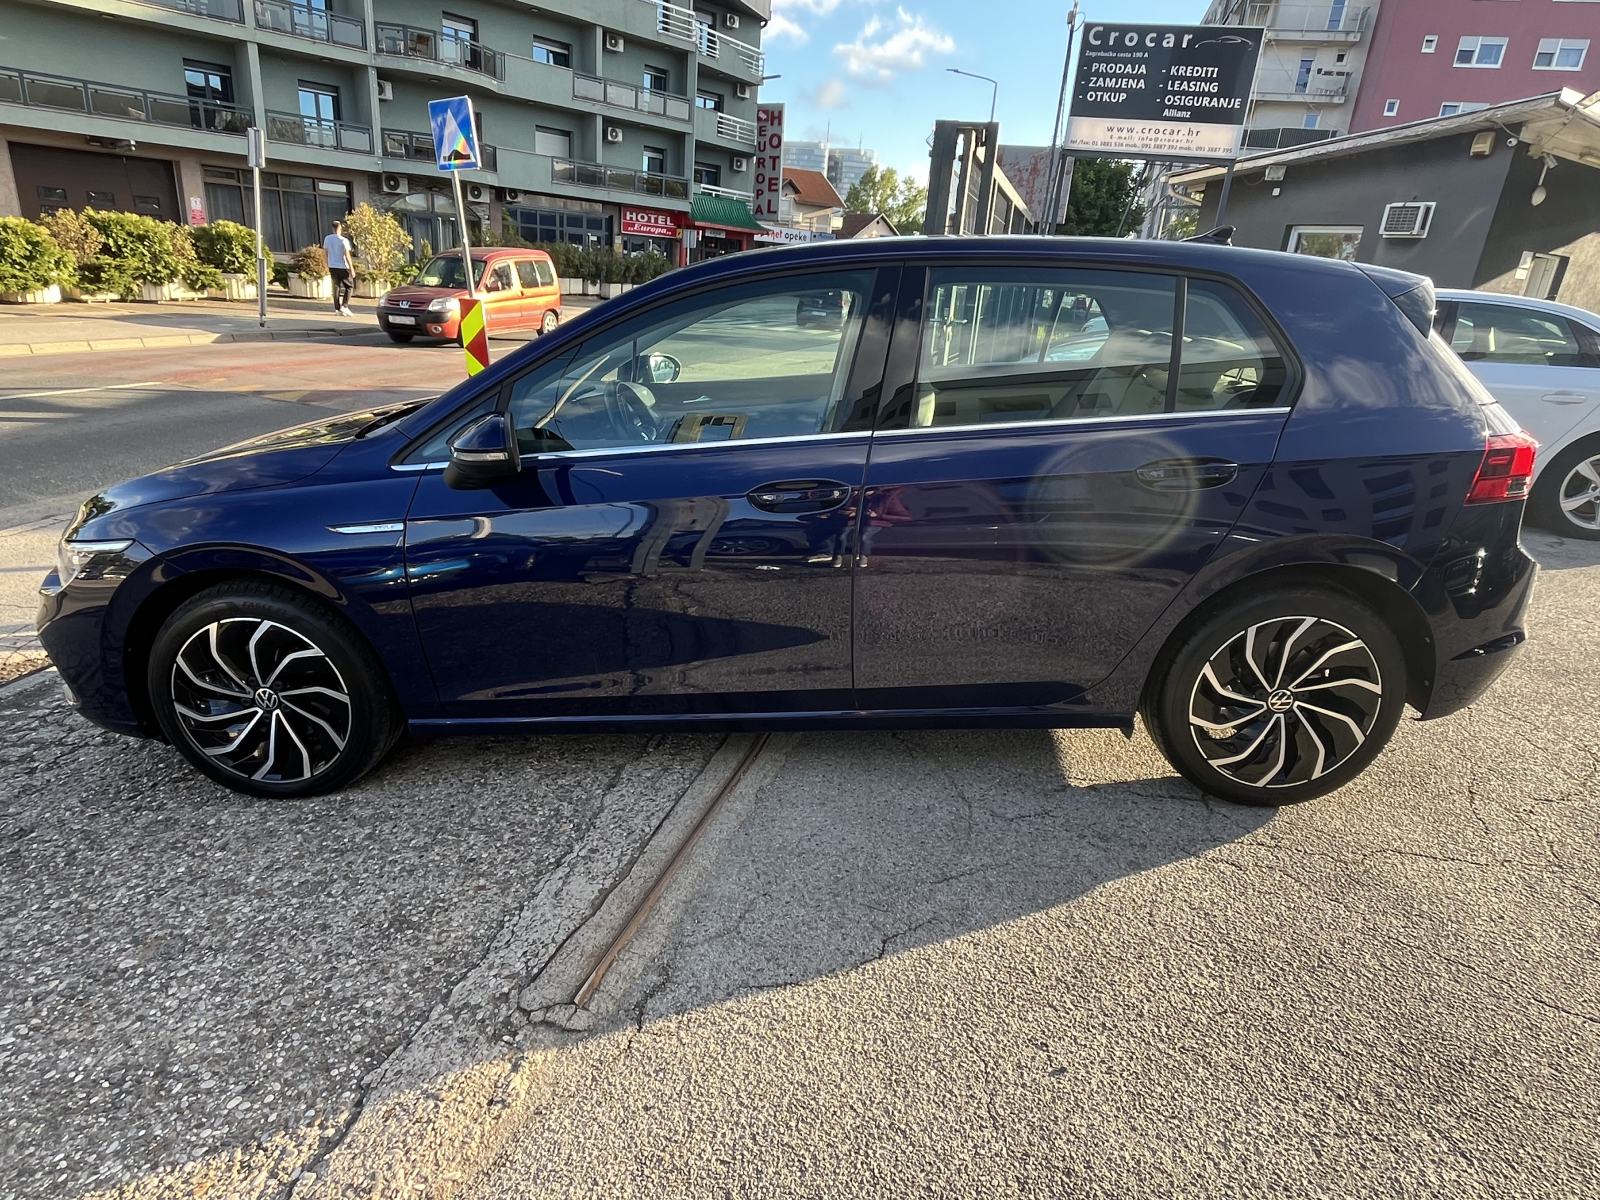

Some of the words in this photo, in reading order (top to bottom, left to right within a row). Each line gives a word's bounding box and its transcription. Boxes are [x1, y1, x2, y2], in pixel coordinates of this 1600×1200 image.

[1088, 26, 1193, 49] Crocar
[1091, 62, 1147, 75] PRODAJA
[1170, 65, 1219, 78] KREDITI
[1088, 77, 1145, 89] ZAMJENA
[1167, 80, 1219, 93] LEASING
[1086, 91, 1127, 103] OTKUP
[1164, 94, 1242, 109] OSIGURANJE
[1162, 108, 1191, 118] Allianz
[1106, 126, 1201, 137] www.crocar.hr
[767, 110, 782, 214] HOTEL
[755, 125, 767, 216] EUROPA
[626, 211, 675, 226] HOTEL
[784, 231, 808, 242] opeke
